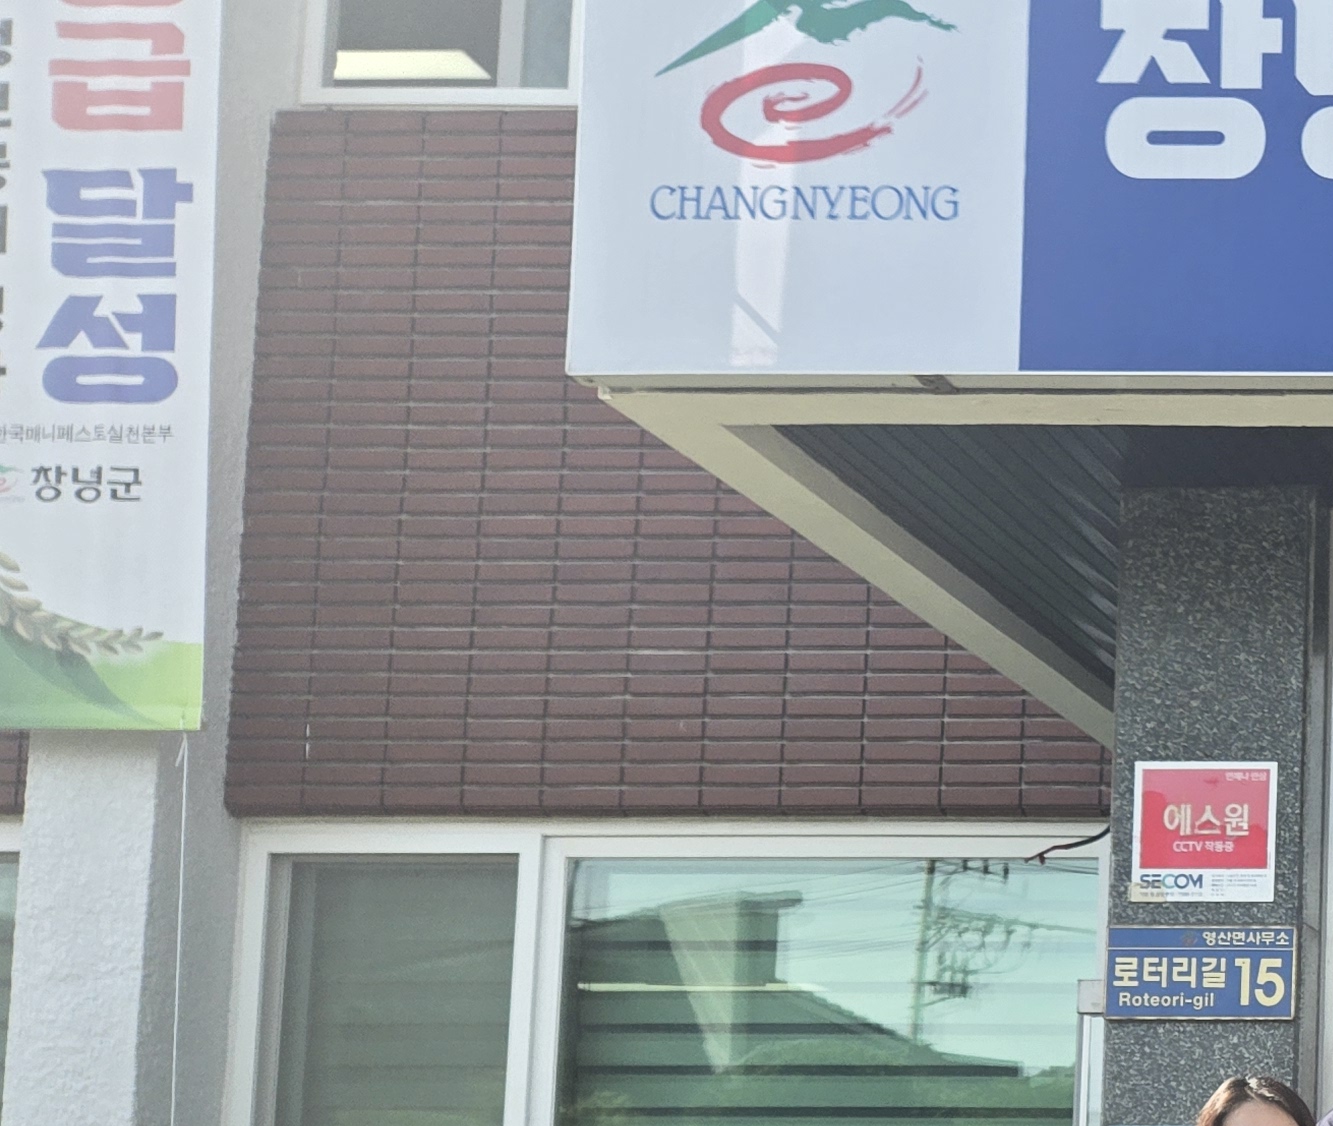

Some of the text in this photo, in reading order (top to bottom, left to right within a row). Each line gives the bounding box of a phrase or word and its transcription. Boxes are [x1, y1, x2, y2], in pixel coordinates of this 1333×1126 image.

[650, 184, 960, 221] CHANGNYEONG
[36, 168, 193, 405] 달성
[31, 466, 142, 503] 창녕군
[1163, 803, 1249, 837] 에스원
[1173, 841, 1202, 852] CCTV
[1140, 874, 1203, 890] SECOM
[1202, 931, 1290, 946] 영산면사무소
[1112, 957, 1286, 1007] 로터리길 15
[1118, 992, 1215, 1010] Roteori-gil
